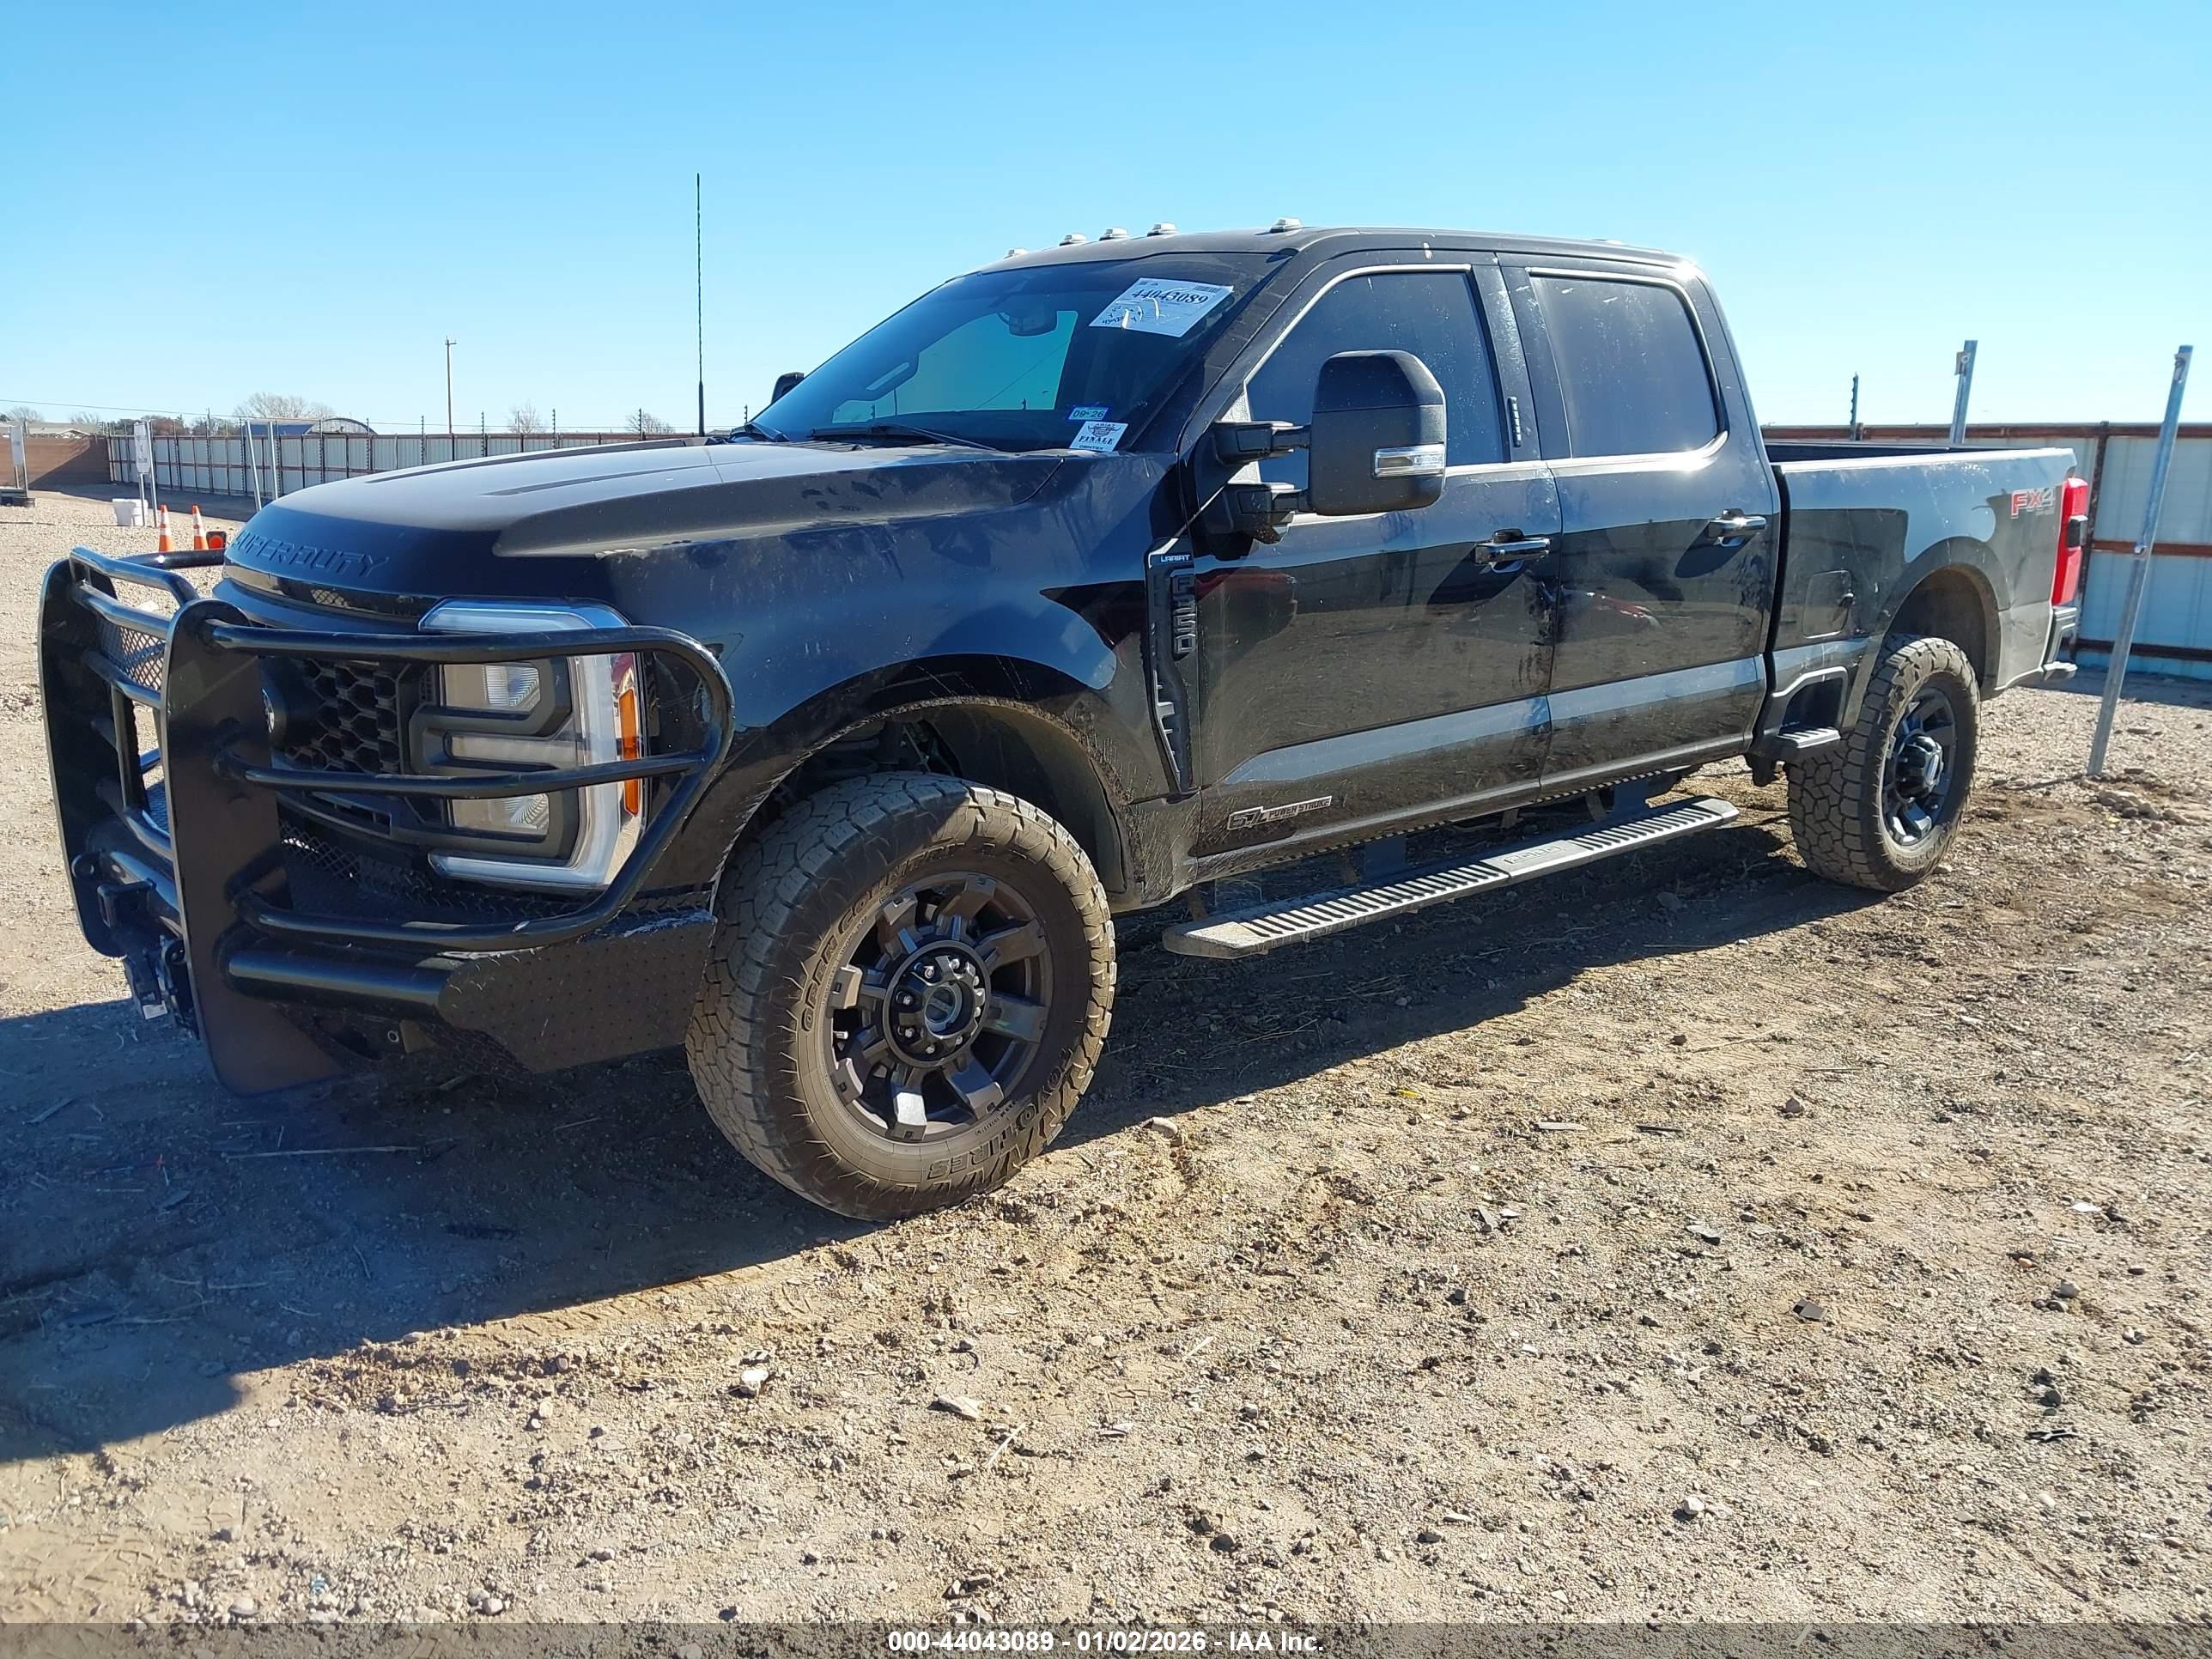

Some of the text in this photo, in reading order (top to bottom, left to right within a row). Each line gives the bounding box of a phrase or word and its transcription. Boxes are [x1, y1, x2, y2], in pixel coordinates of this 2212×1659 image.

[1132, 289, 1209, 304] 44043089
[1079, 435, 1115, 445] FINALE
[2010, 488, 2055, 519] FX4
[289, 544, 390, 577] DUTY
[1160, 554, 1190, 562] LARIAT
[1268, 805, 1297, 819] POWER
[801, 934, 841, 1032] OPEN
[927, 1121, 1015, 1181] TIRES
